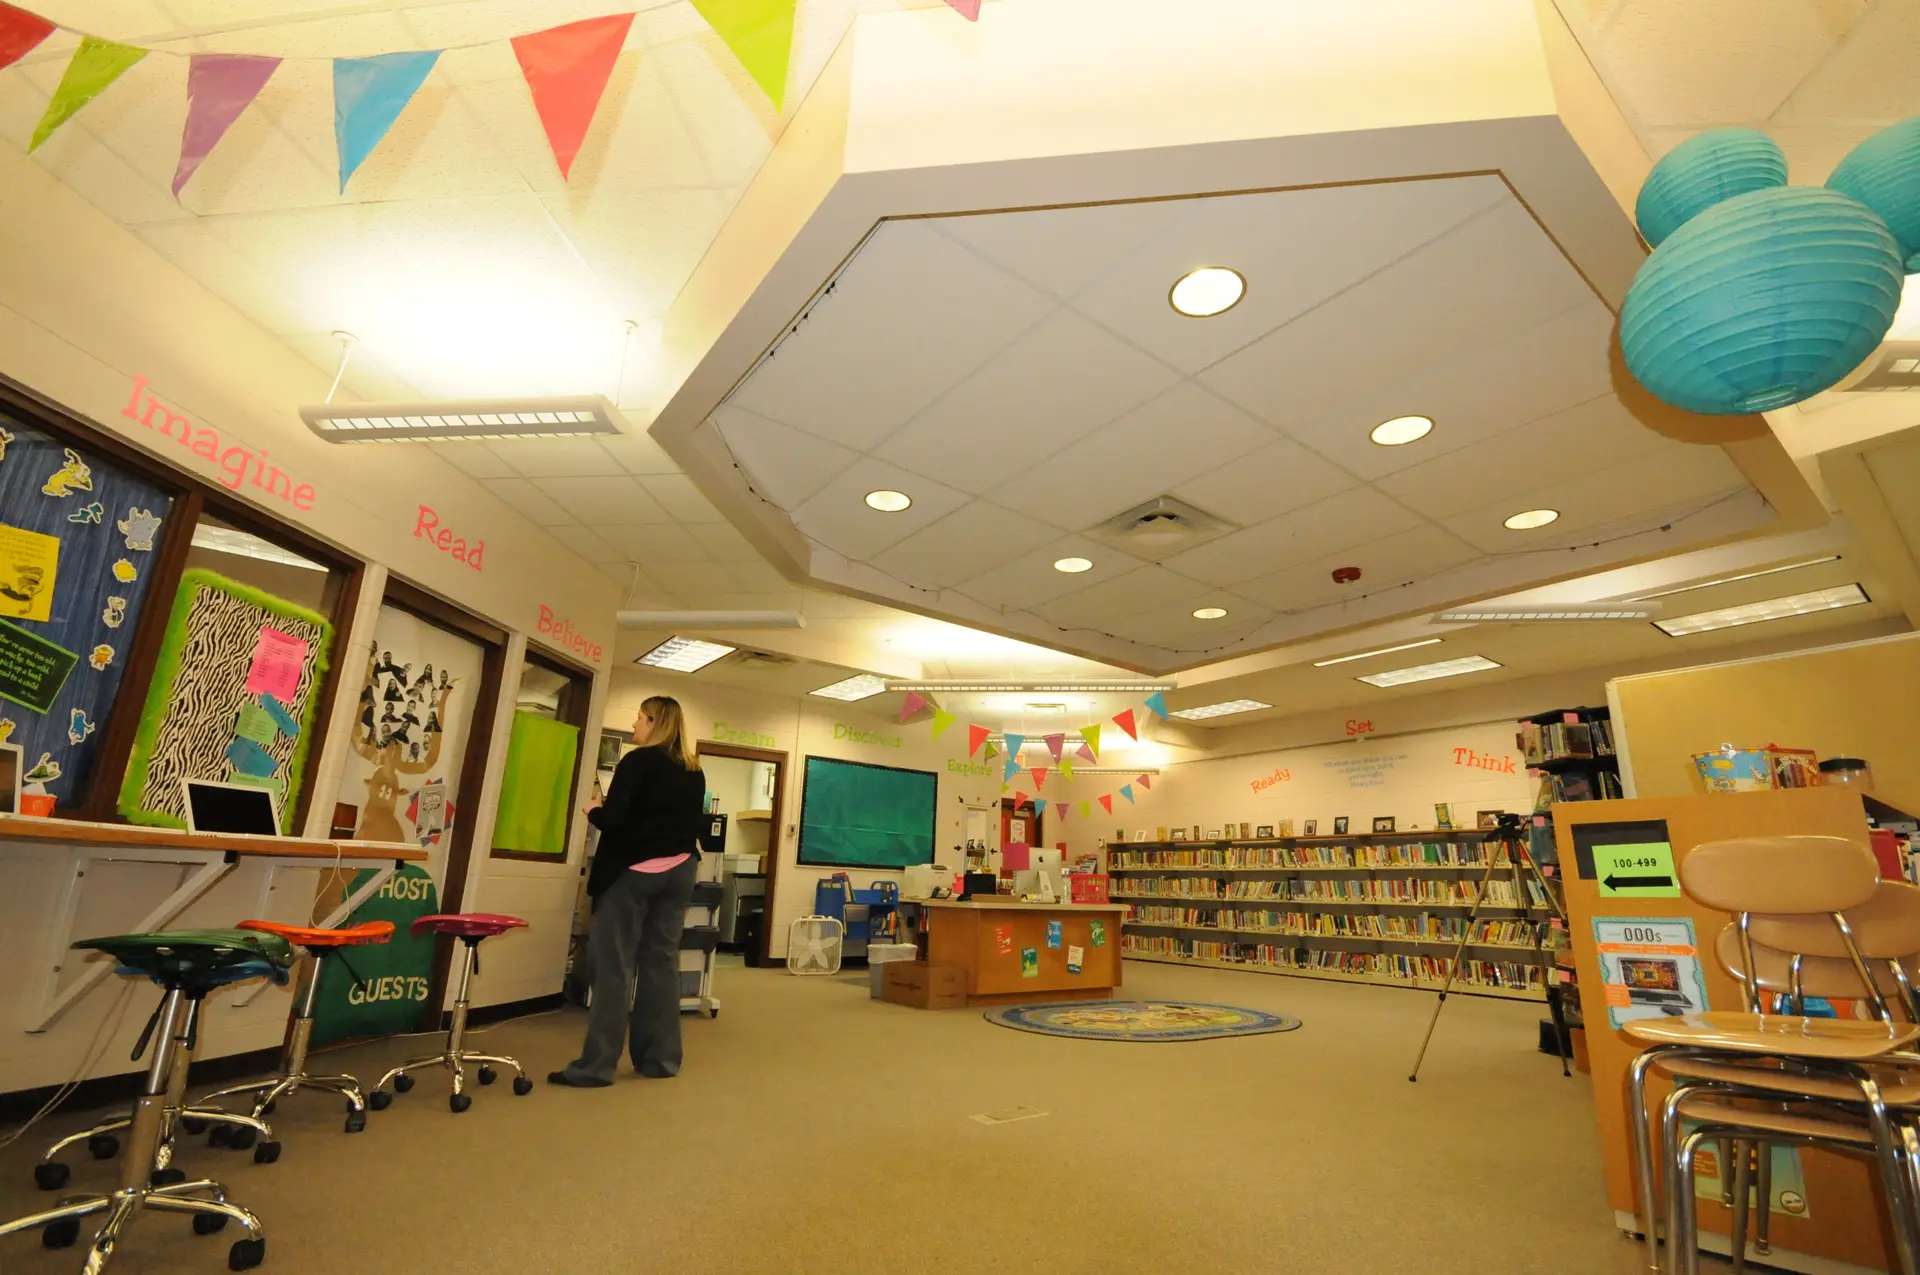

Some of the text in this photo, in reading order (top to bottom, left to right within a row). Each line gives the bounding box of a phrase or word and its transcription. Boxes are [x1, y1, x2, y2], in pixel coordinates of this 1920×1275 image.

[121, 372, 316, 511] Imagine
[412, 503, 485, 572] Read
[536, 603, 603, 663] Believe
[712, 721, 776, 748] Dream
[833, 722, 903, 749] Discover
[1345, 718, 1375, 737] Set
[947, 758, 993, 777] Explore
[1452, 746, 1517, 775] Think
[1250, 768, 1292, 794] Ready
[1613, 857, 1658, 869] 100-499
[379, 875, 433, 901] HOST
[1623, 927, 1663, 943] 000s
[348, 975, 430, 1005] GUESTS
